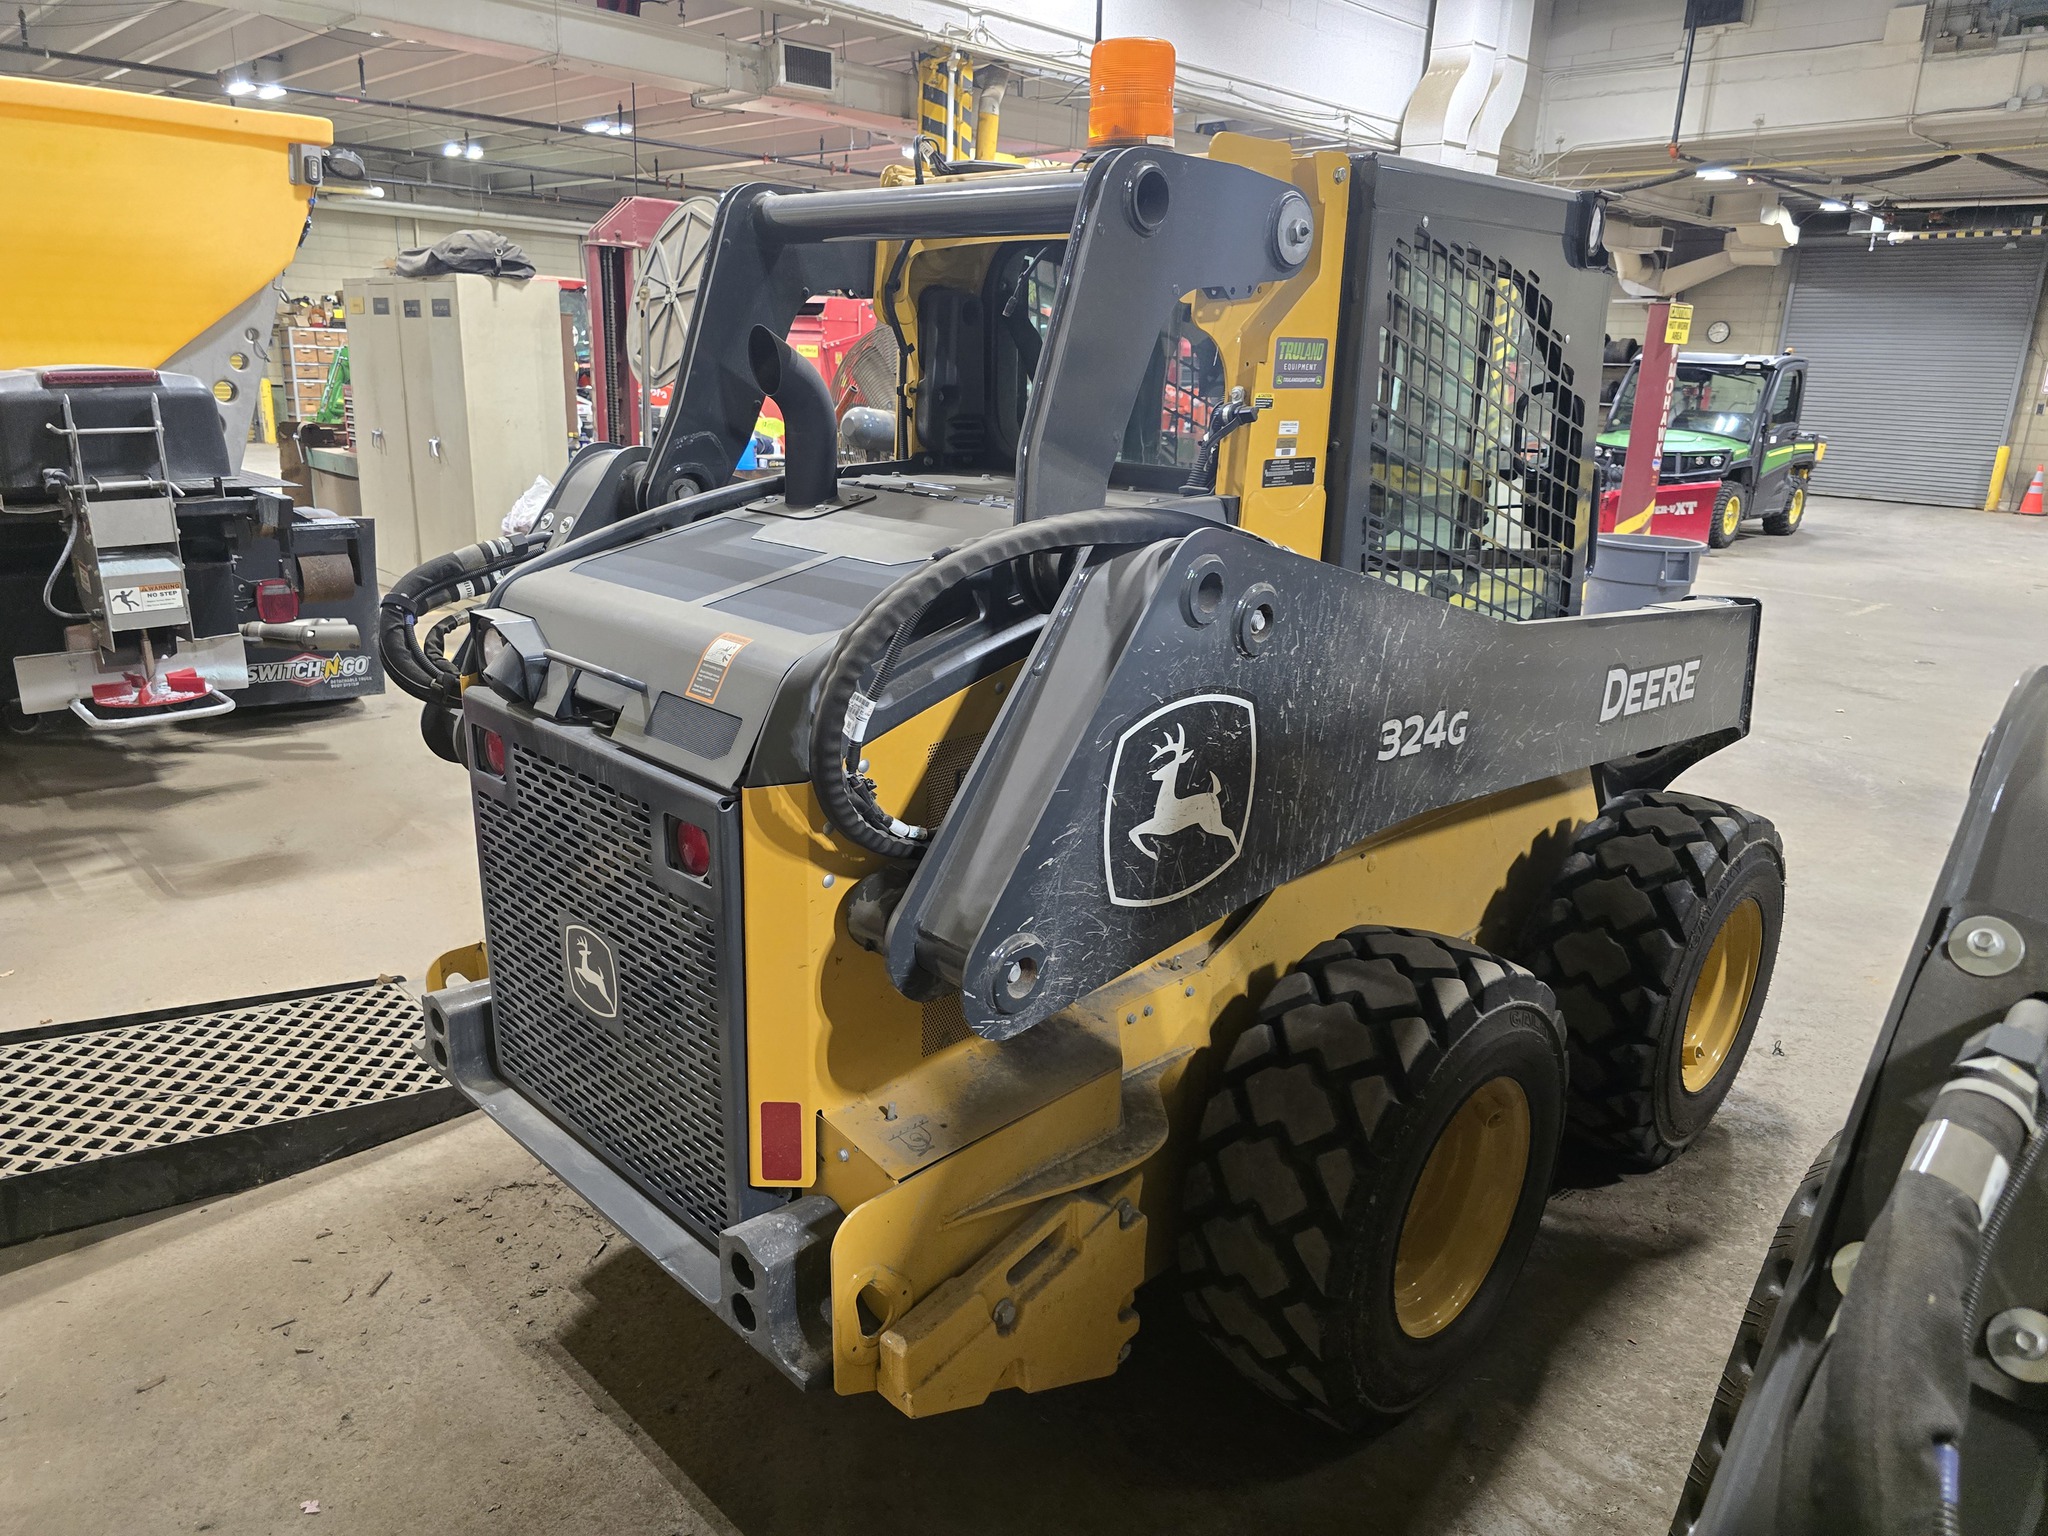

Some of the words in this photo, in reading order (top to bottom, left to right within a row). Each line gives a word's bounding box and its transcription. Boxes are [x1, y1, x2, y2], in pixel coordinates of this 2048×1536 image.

[1279, 341, 1325, 361] TRULAND
[1283, 363, 1318, 371] EQUIPMENT
[1654, 362, 1678, 457] MOHAWK
[148, 583, 180, 592] WARNING
[1600, 659, 1701, 723] DEERE
[1377, 710, 1469, 762] 324G
